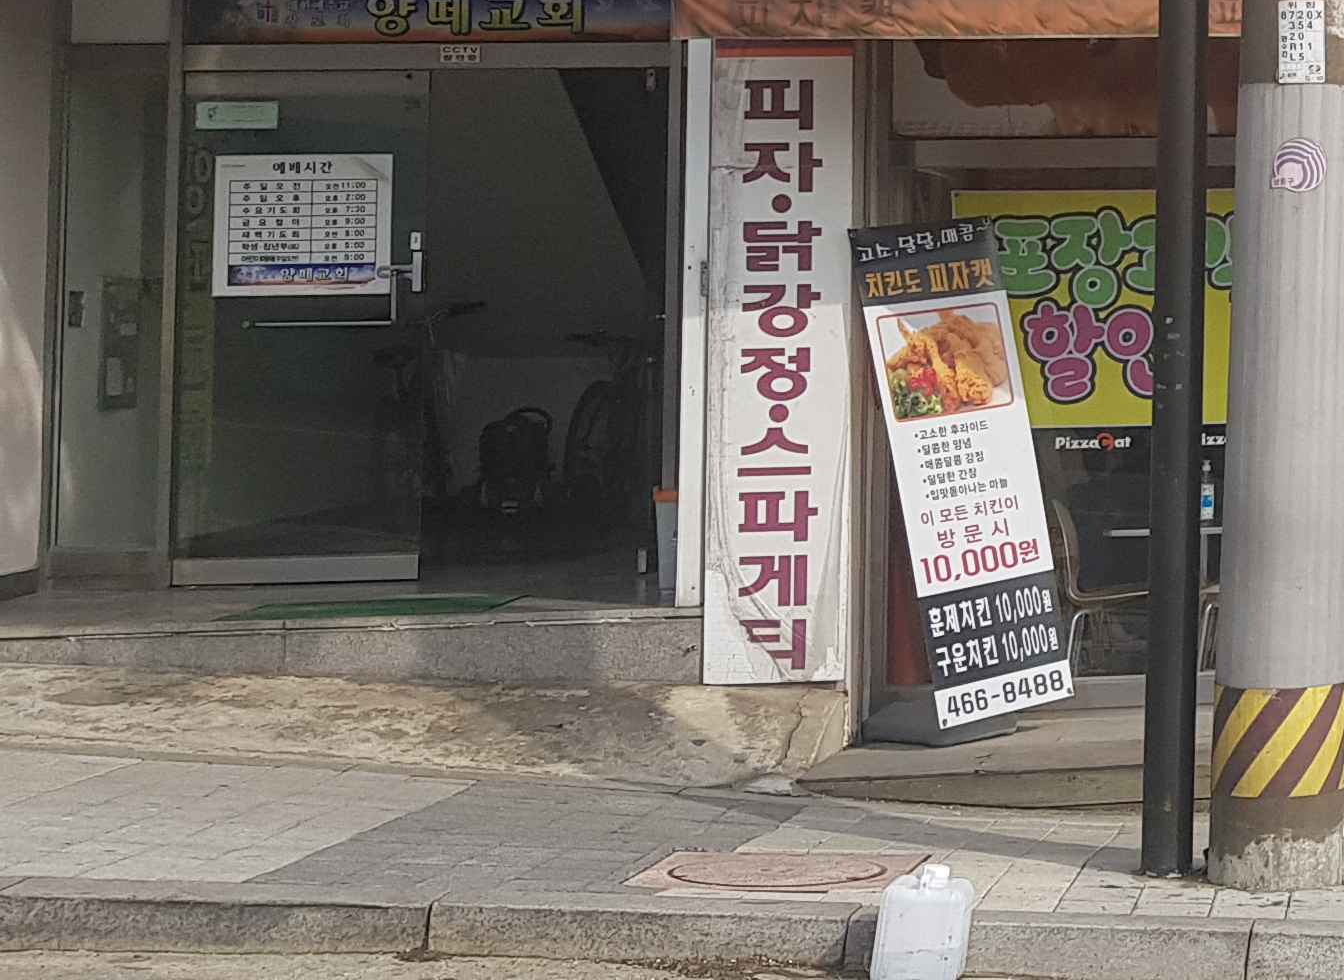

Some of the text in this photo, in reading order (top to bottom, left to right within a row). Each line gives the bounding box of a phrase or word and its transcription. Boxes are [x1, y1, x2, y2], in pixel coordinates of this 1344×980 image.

[1281, 10, 1323, 20] 8720X
[1289, 21, 1313, 30] 354
[442, 46, 478, 54] CCTV
[272, 161, 333, 175] 예배시간
[864, 257, 996, 299] 치킨도 피자캣
[920, 494, 1020, 527] 이 모든 치킨이
[919, 538, 1041, 585] 10,000원
[927, 585, 1053, 638] 훈제치킨 10,000원
[934, 623, 1059, 677] 구운치킨 10,000원
[946, 668, 1065, 719] 466-8488
